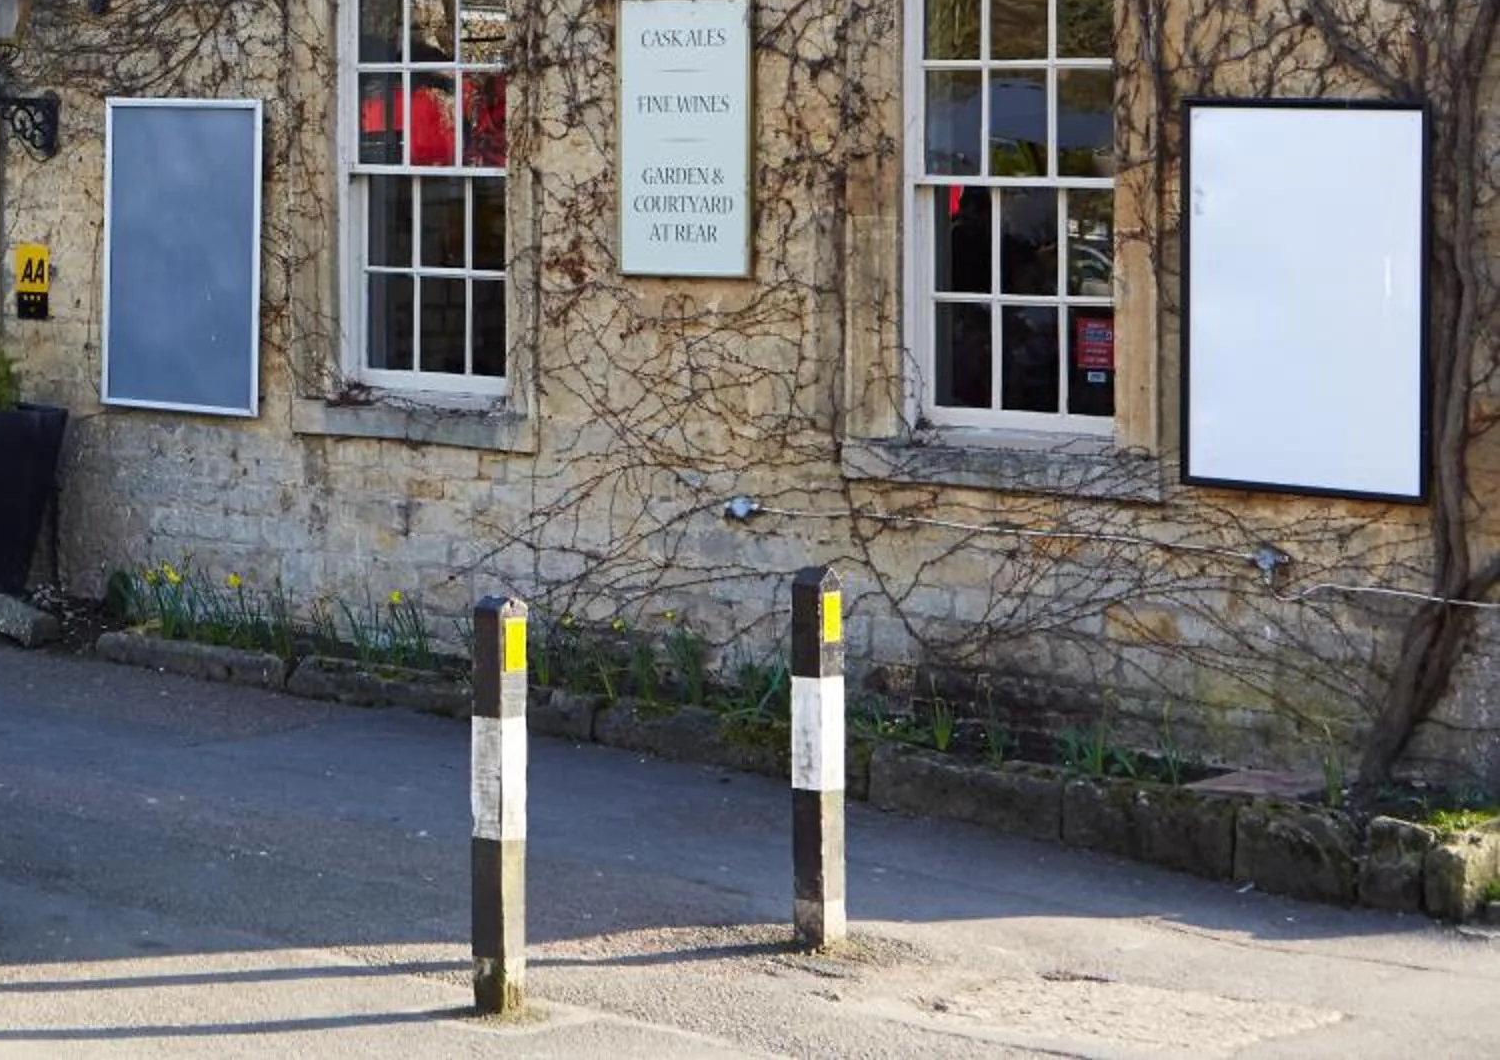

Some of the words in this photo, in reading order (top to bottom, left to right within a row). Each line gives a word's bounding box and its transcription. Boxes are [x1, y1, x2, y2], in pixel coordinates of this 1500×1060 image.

[641, 29, 683, 47] CASK
[685, 28, 726, 47] ALES
[637, 96, 674, 114] FINE
[676, 95, 730, 114] WINES
[641, 167, 709, 186] GARDEN
[711, 167, 725, 185] &
[633, 195, 734, 214] COURTYARD
[649, 224, 671, 243] AT
[674, 224, 718, 244] REAR
[20, 257, 45, 284] AA
